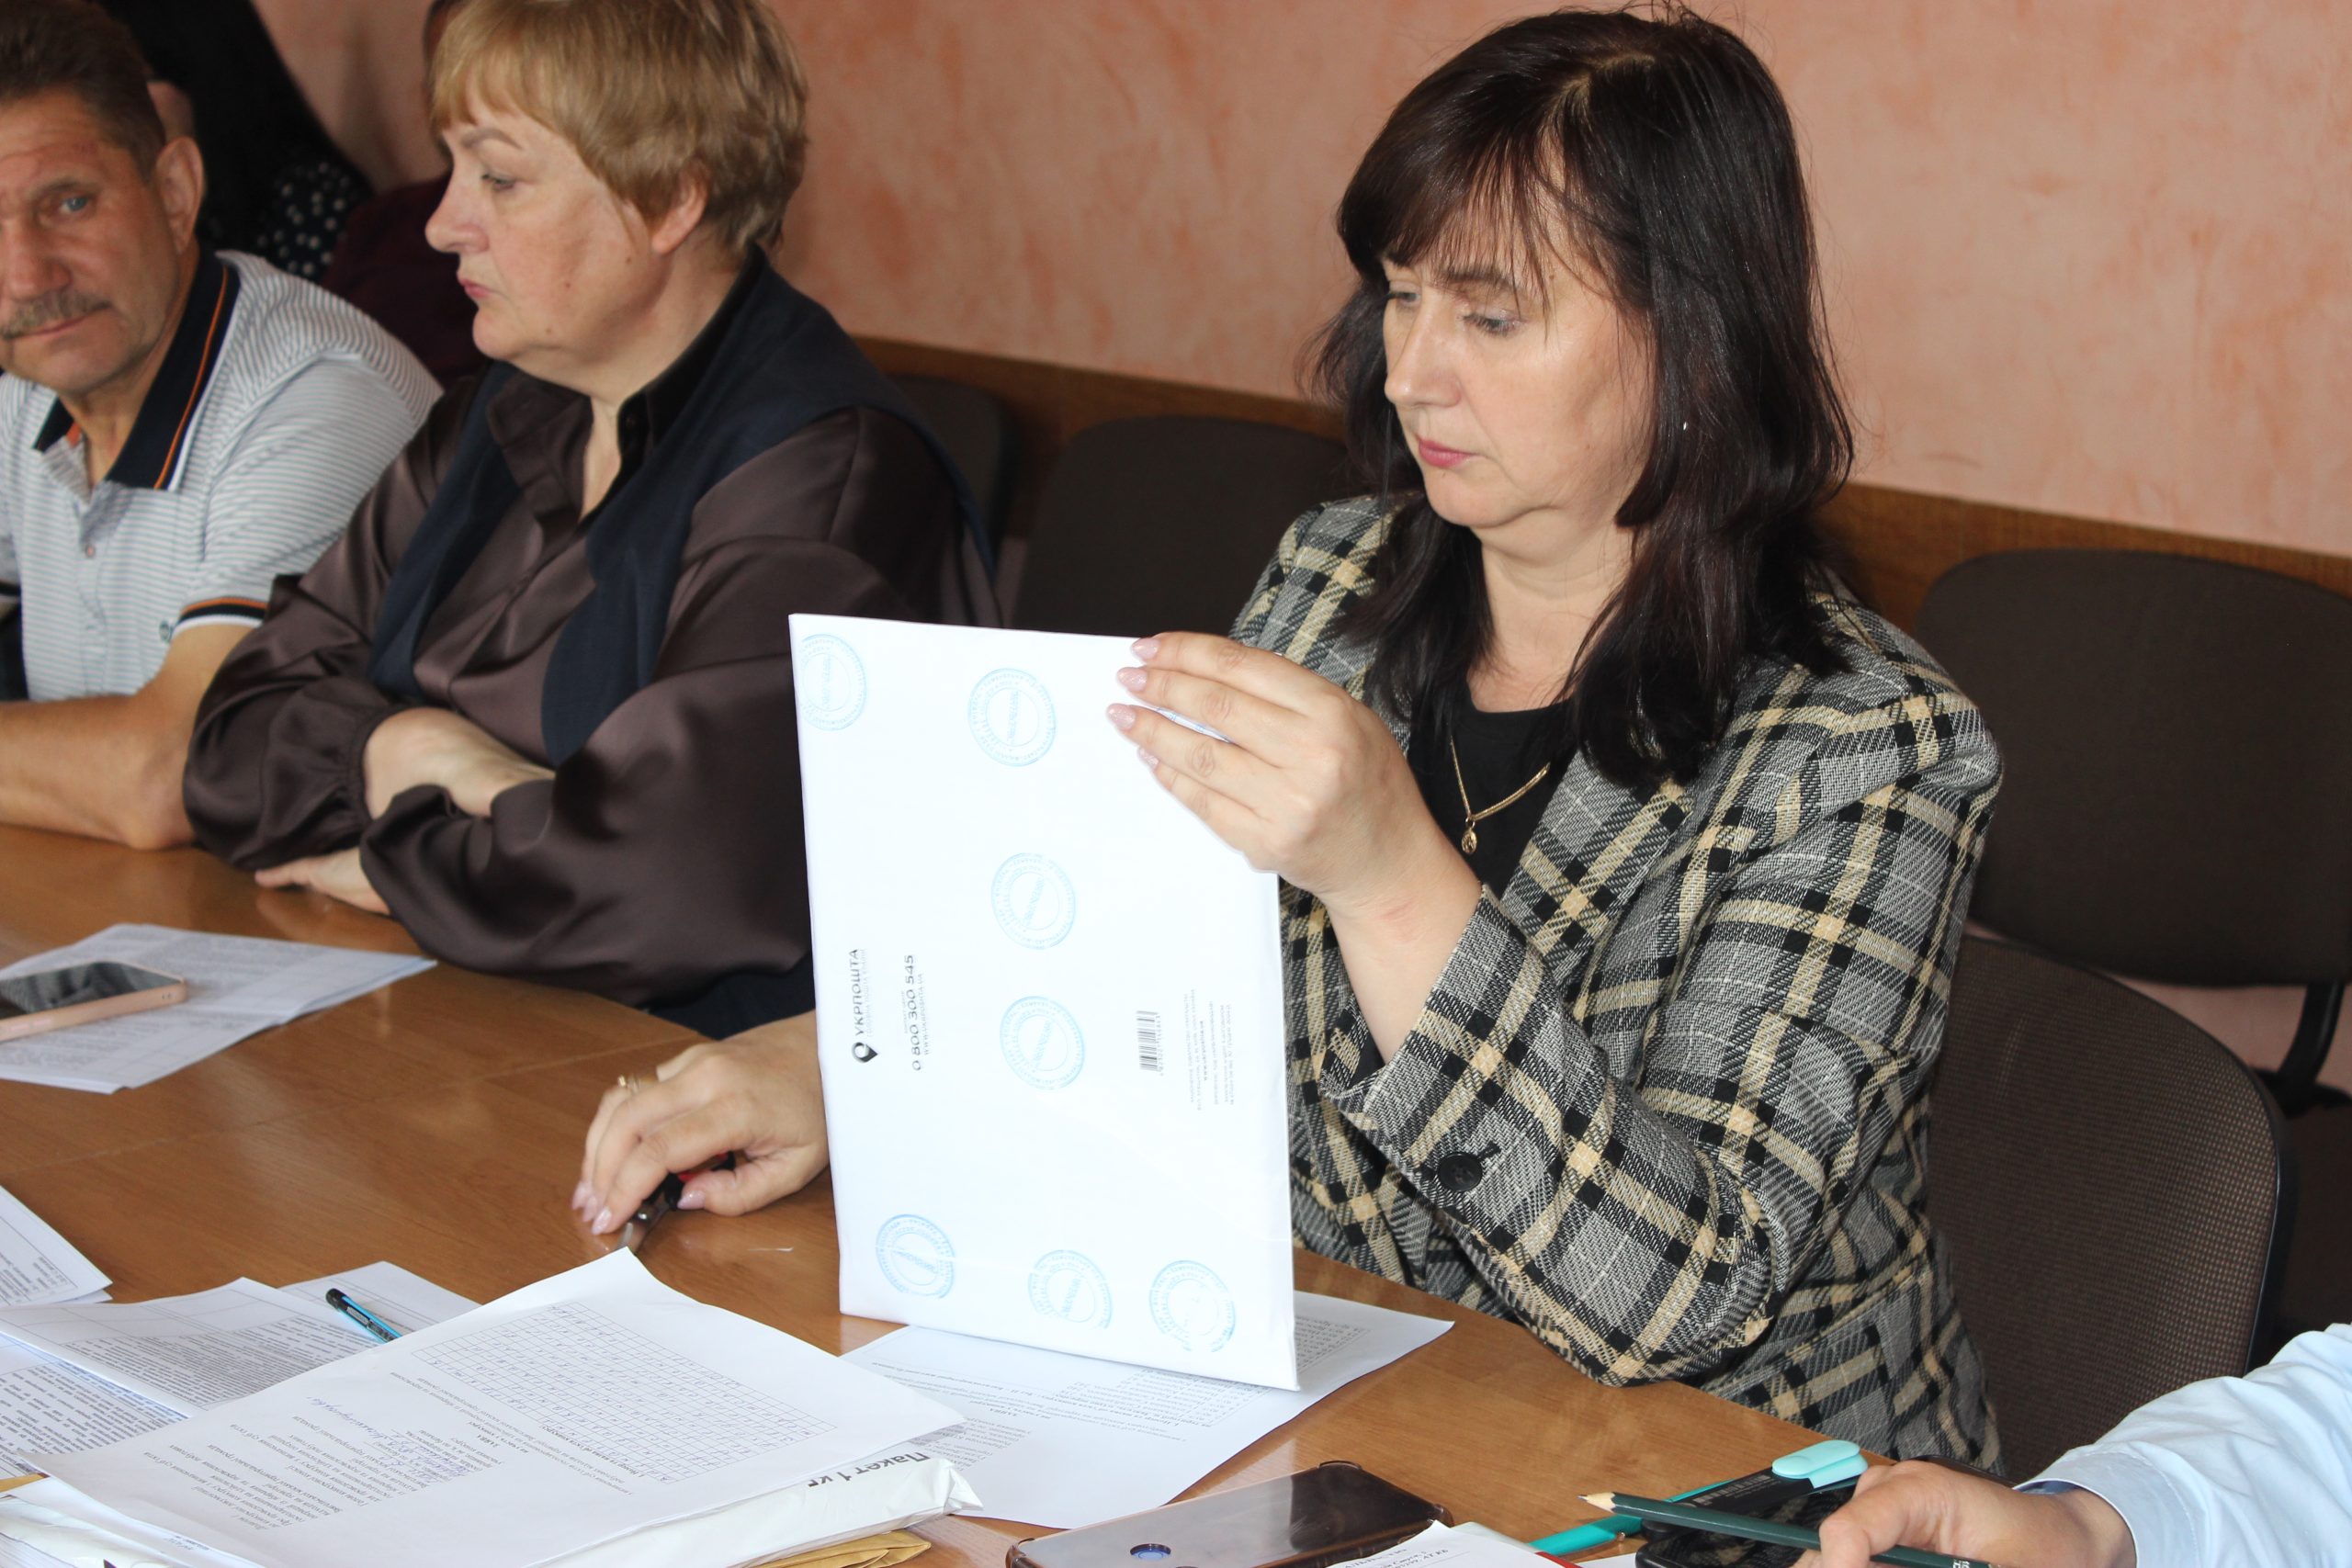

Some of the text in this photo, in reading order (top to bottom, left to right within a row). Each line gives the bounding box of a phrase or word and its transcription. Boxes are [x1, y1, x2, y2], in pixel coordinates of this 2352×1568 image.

[904, 955, 915, 985] 545
[848, 949, 865, 1037] УКРПОШТА
[906, 989, 918, 1021] 300
[910, 1024, 922, 1056] 800
[837, 1472, 852, 1481] 1
[855, 1452, 931, 1474] Пакет
